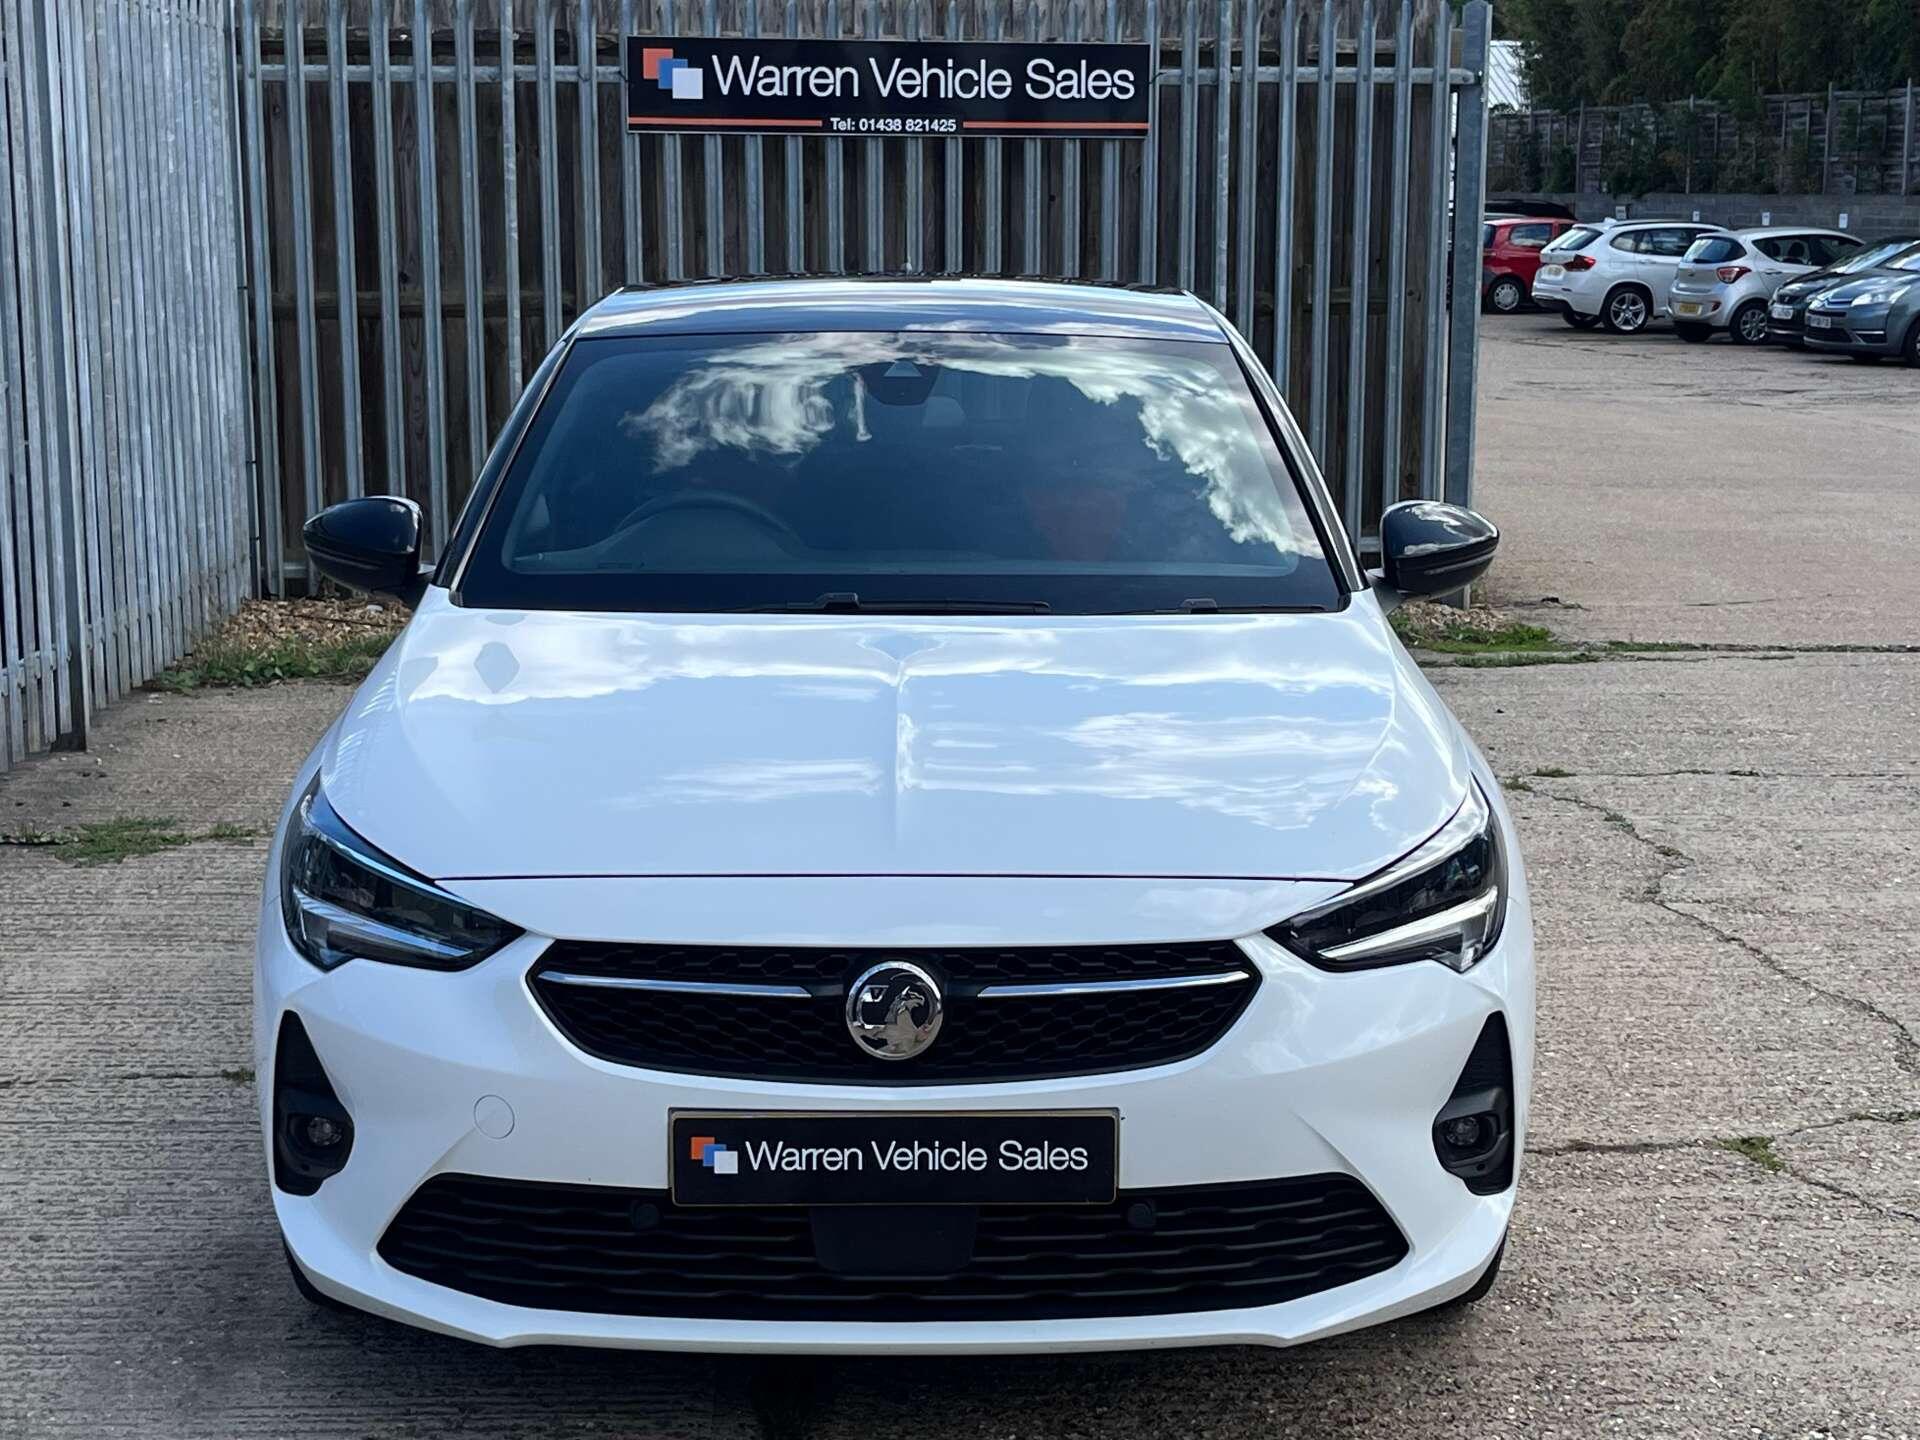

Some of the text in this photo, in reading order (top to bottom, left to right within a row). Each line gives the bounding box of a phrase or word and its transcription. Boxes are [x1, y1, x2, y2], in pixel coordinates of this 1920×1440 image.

[711, 54, 1135, 99] Warren Vehicle Sales
[830, 117, 957, 132] Tel: 01438 821425
[745, 1140, 1089, 1170] Warren Vehicle Sales
